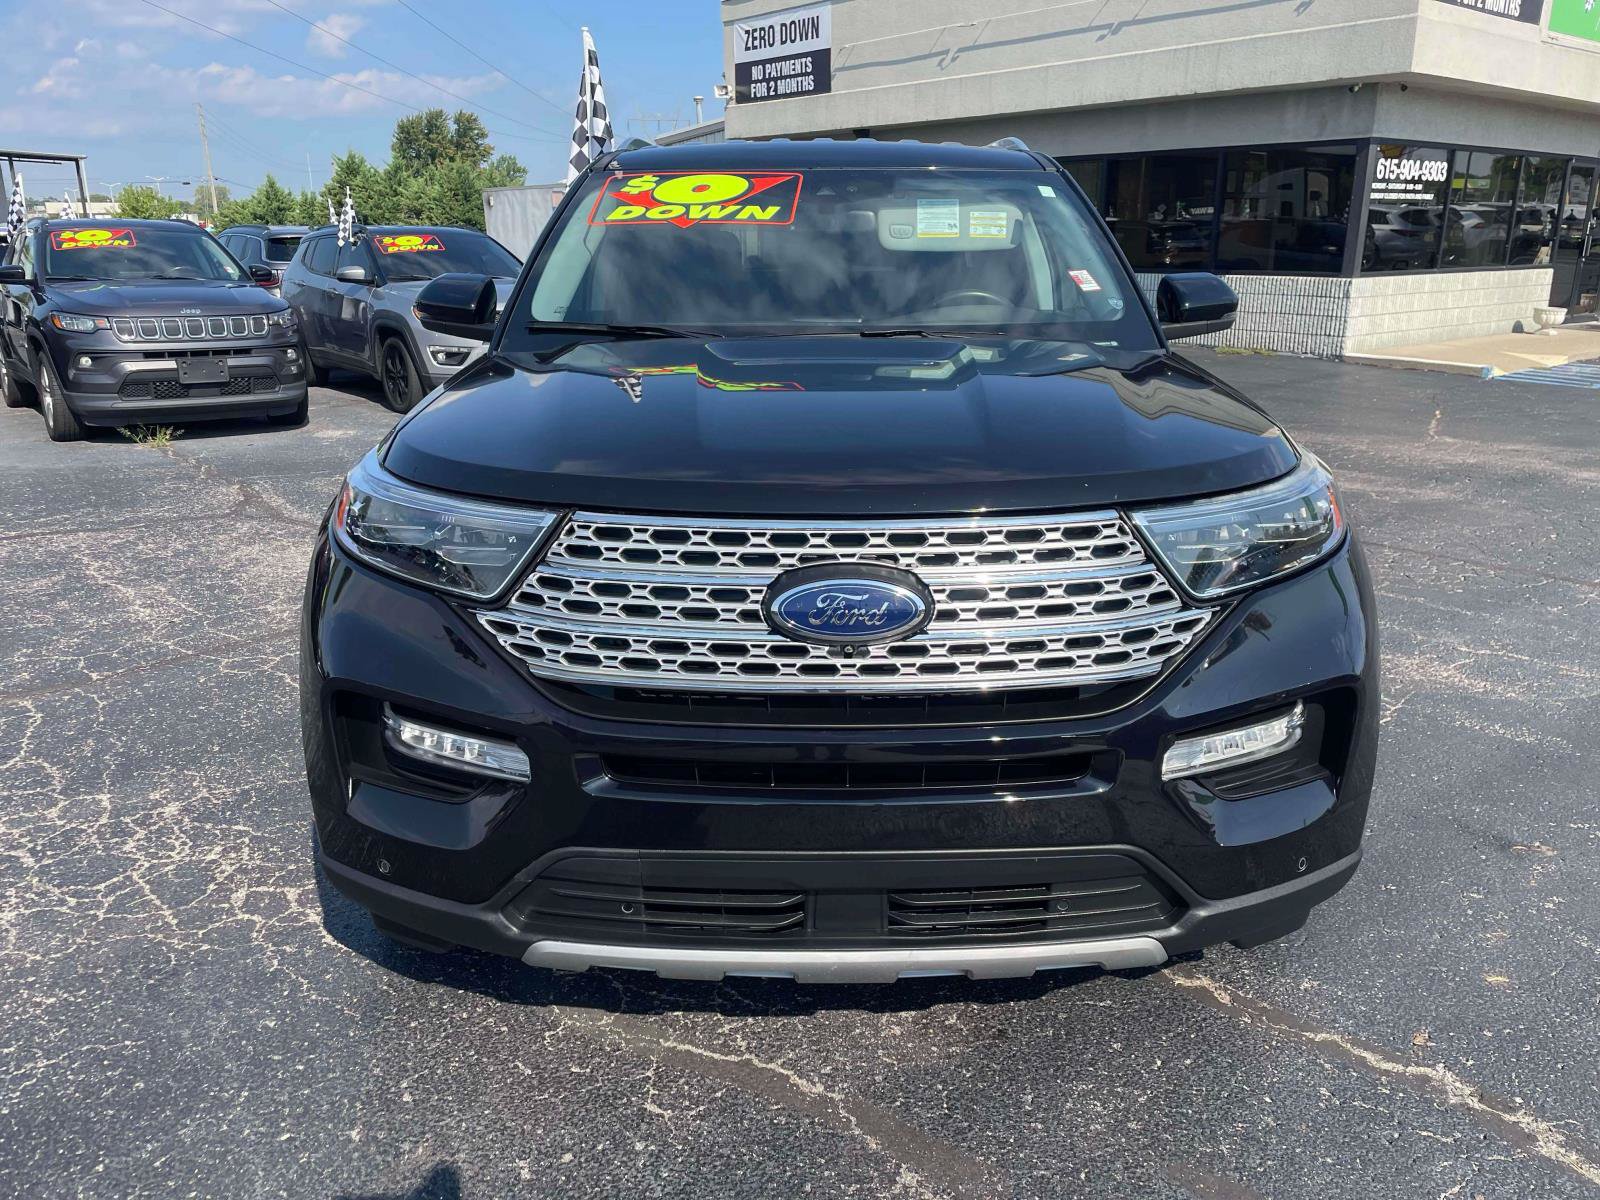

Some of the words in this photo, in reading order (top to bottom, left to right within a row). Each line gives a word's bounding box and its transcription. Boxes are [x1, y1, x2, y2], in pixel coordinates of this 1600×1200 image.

[744, 25, 775, 51] ZERO
[780, 15, 820, 45] DOWN
[751, 64, 763, 81] NO
[765, 57, 812, 79] PAYMENTS
[751, 82, 768, 98] FOR
[769, 81, 775, 96] 2
[777, 75, 814, 95] MONTHS
[1376, 157, 1448, 182] 615-904-9303
[605, 205, 781, 220] DOWN
[62, 240, 130, 248] DOWN
[387, 244, 439, 253] DOWN
[808, 592, 889, 626] Ford
